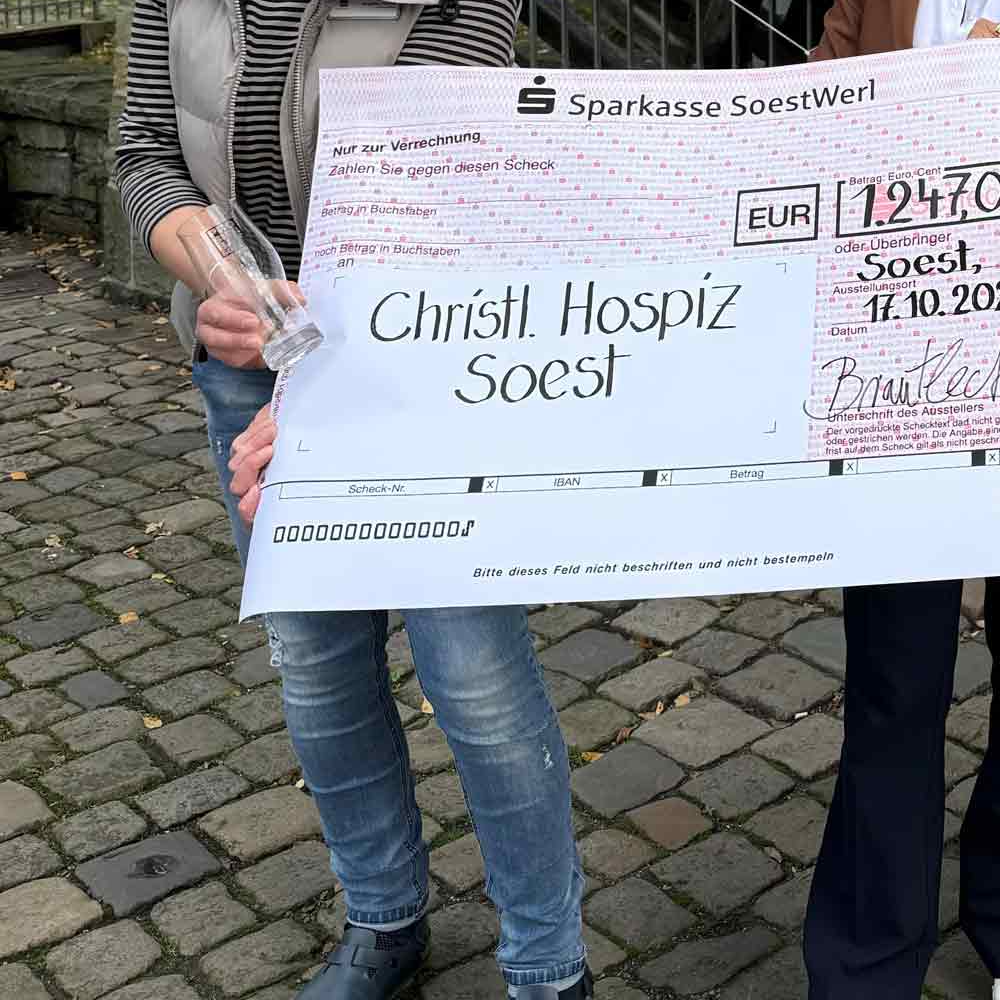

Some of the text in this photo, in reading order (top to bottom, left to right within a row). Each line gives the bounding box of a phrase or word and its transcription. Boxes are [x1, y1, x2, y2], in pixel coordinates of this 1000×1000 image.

[568, 79, 875, 120] Sparkasse SoestWerl
[333, 131, 481, 158] Nur zur Verrechnung
[328, 158, 555, 179] Zahlen Sie gegen diesen Scheck
[917, 166, 942, 178] Cent
[321, 205, 437, 217] Betrag in Buchstaben
[748, 204, 811, 230] EUR
[315, 243, 460, 257] noch Betrag in Buchstaben
[834, 233, 952, 254] oder Überbringer
[337, 257, 354, 268] an
[857, 240, 982, 282] Soest,
[832, 280, 917, 296] Ausstellungsort
[370, 272, 742, 343] Christl. Hospiz
[831, 324, 868, 337] Datum
[454, 343, 632, 404] Soest
[827, 403, 985, 423] Unterschrift des Ausstellers
[827, 427, 843, 437] Der
[845, 423, 901, 436] vorgedruckte
[903, 420, 950, 431] Schecktext
[972, 415, 992, 425] nicht
[825, 446, 842, 456] frist
[844, 445, 857, 454] auf
[860, 444, 880, 454] dem
[882, 441, 914, 452] Scheck
[916, 440, 930, 450] gilt
[931, 438, 945, 448] als
[946, 437, 967, 448] nicht
[826, 436, 846, 447] oder
[848, 432, 893, 445] gestrichen
[932, 429, 947, 438] Die
[949, 427, 983, 439] Angabe
[348, 484, 406, 496] Scheck-Nr.
[553, 477, 581, 488] IBAN
[730, 467, 764, 480] Betrag
[473, 551, 834, 577] Bitte dieses Feld nicht beschriften und nicht bestempeln
